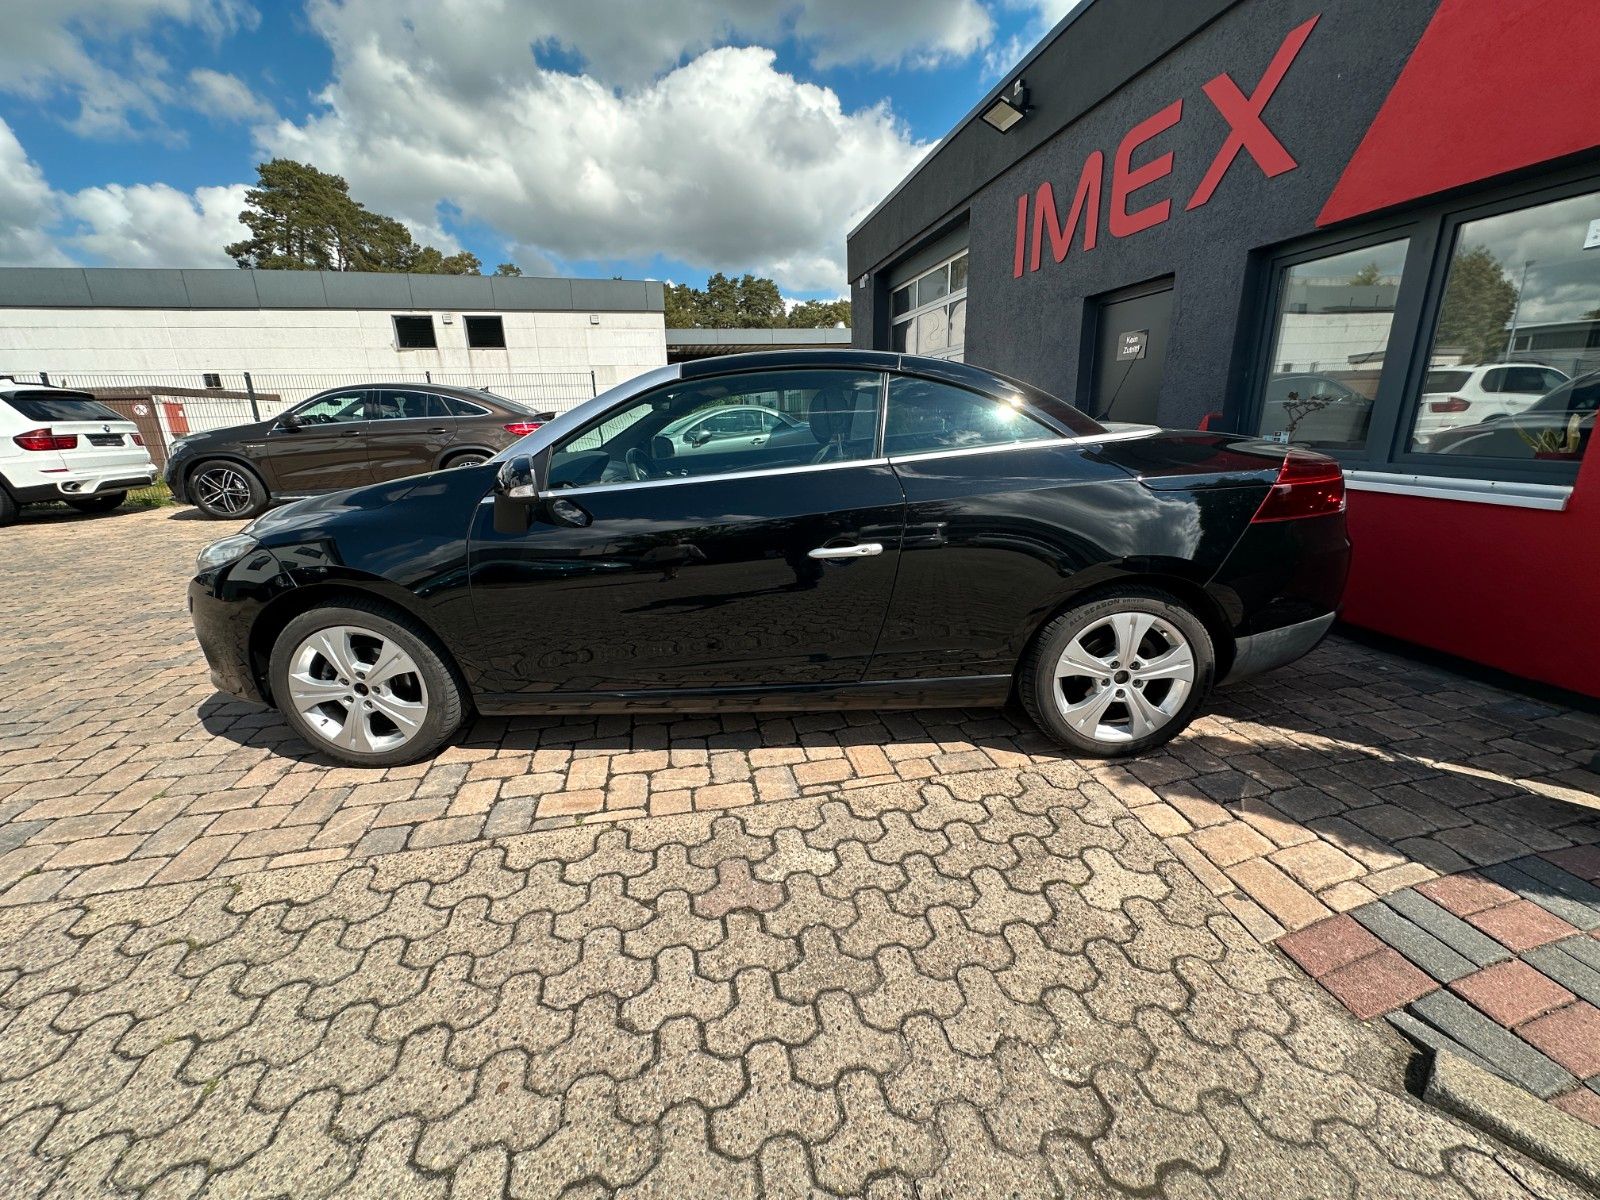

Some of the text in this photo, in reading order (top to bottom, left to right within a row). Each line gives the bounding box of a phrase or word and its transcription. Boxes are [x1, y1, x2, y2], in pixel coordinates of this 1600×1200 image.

[1013, 14, 1321, 278] IMEX
[1126, 336, 1139, 344] Kein
[1069, 614, 1084, 627] ALL
[1084, 598, 1120, 615] SEASON
